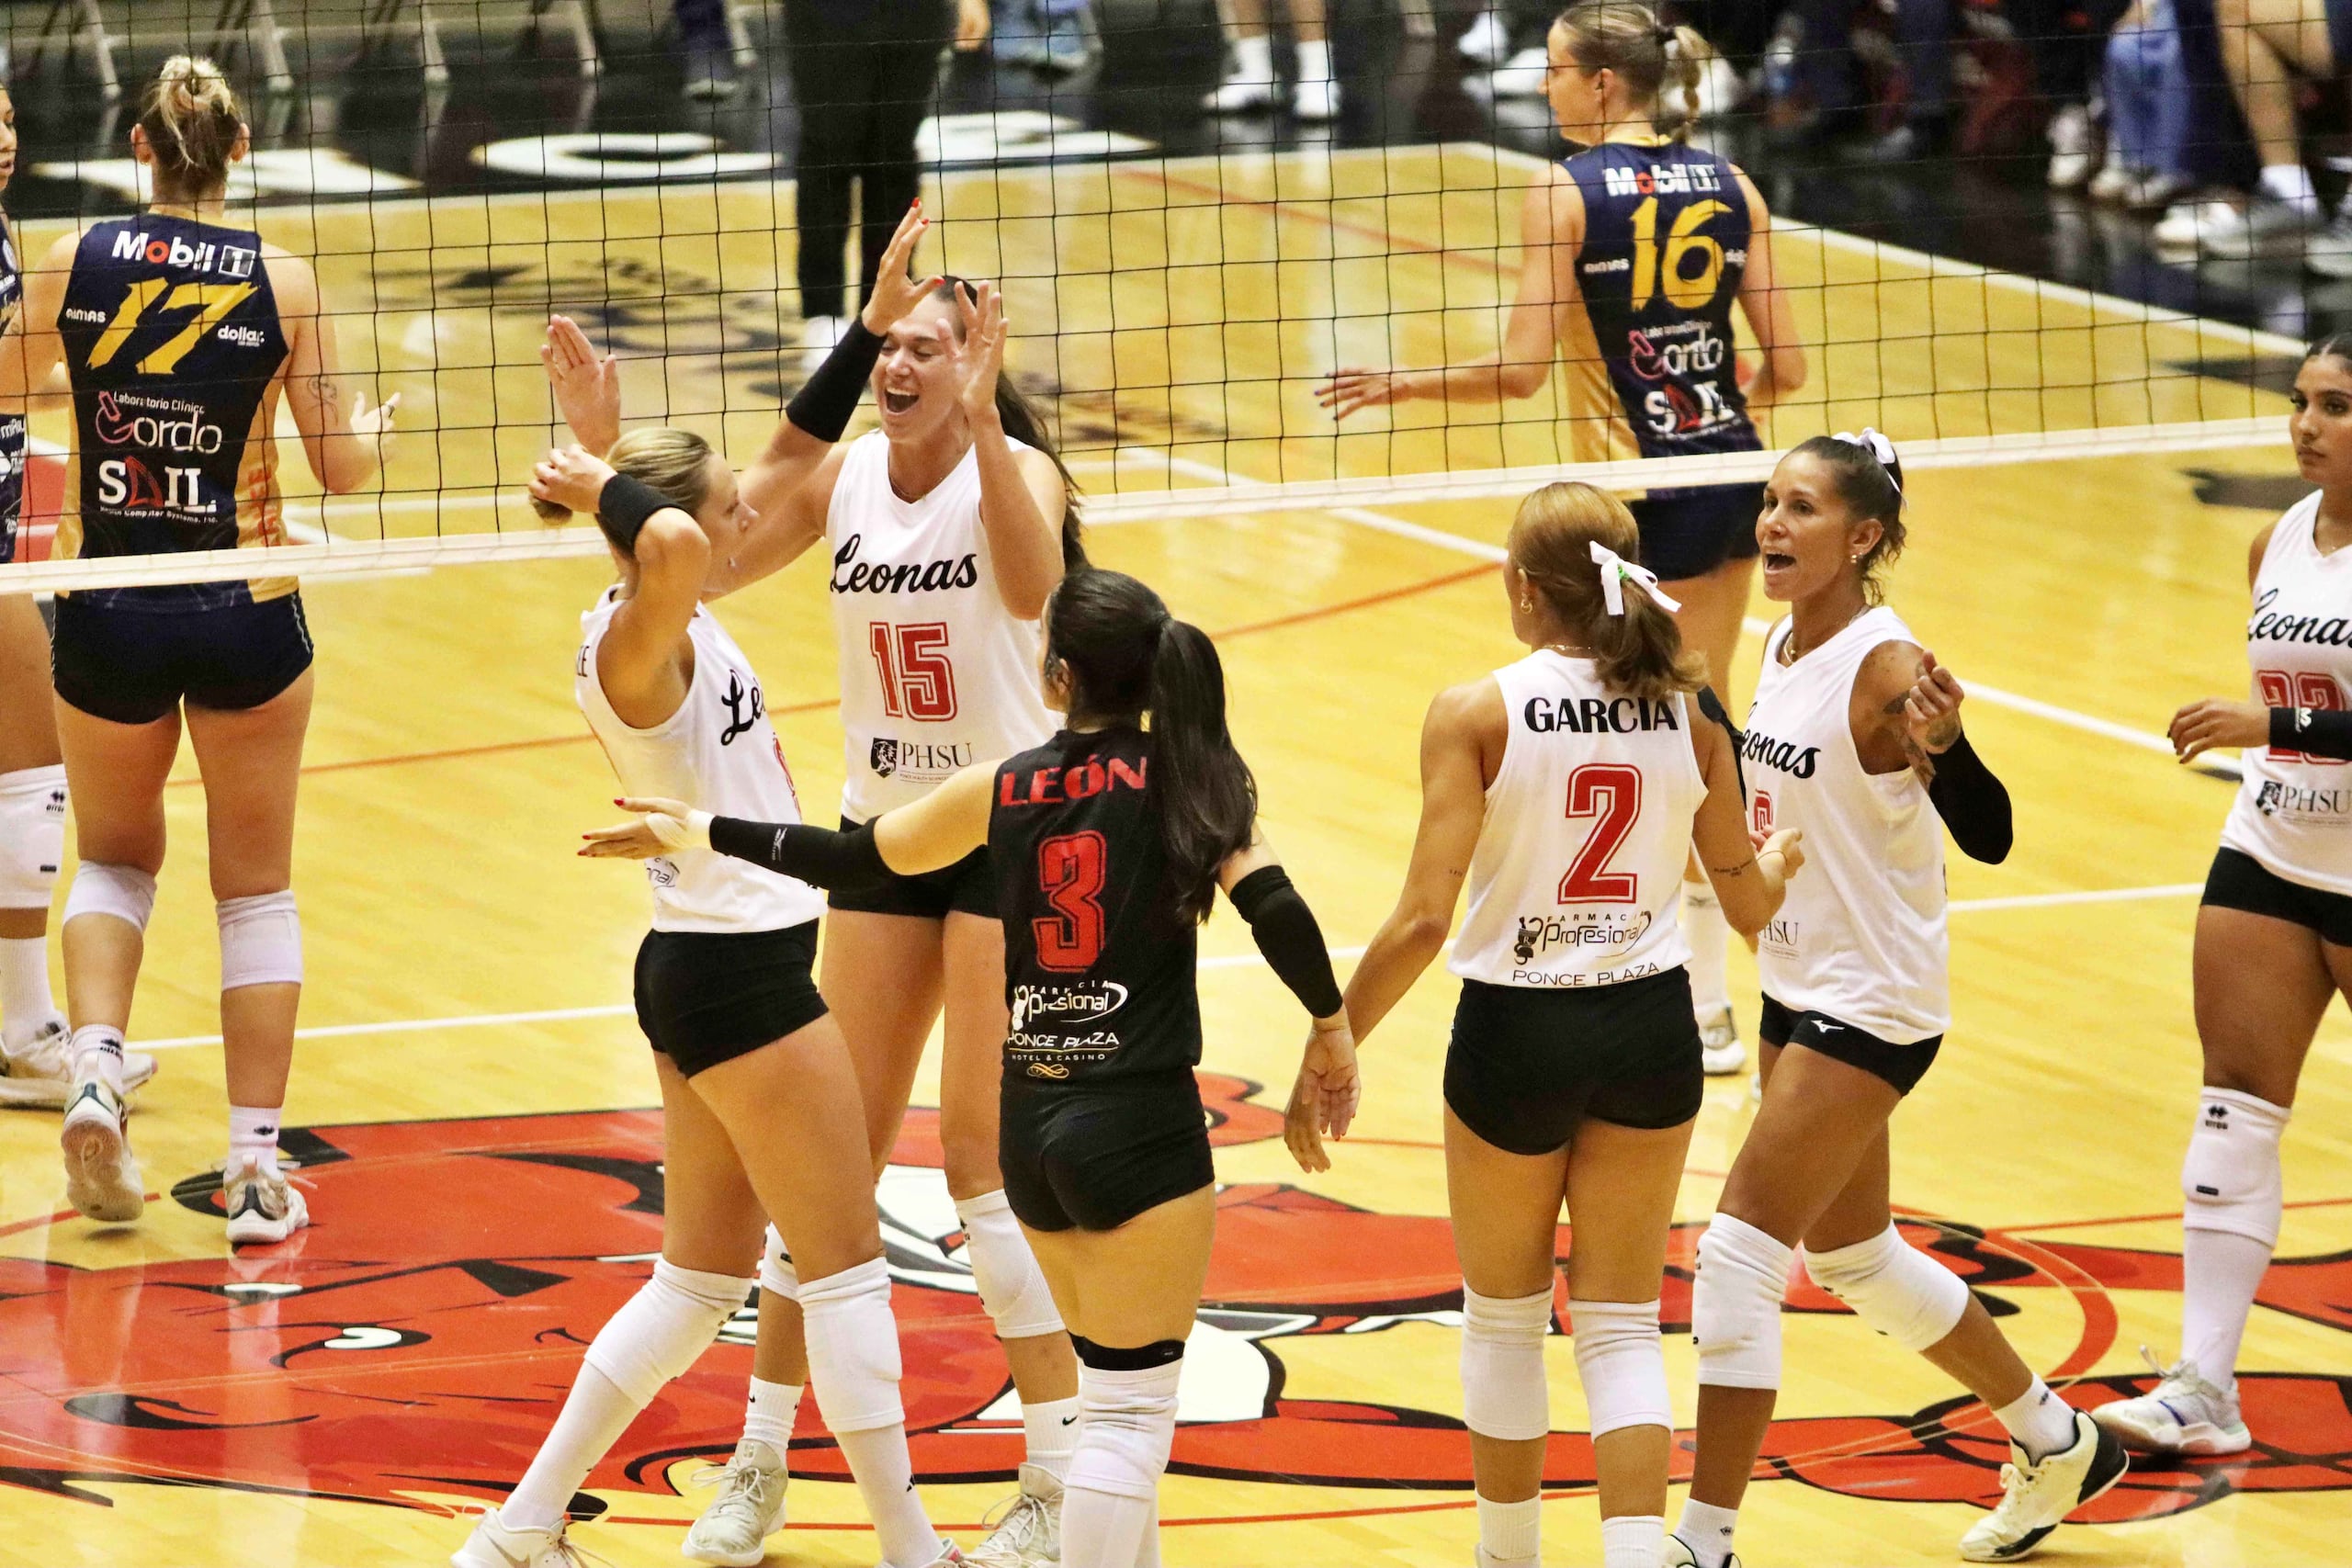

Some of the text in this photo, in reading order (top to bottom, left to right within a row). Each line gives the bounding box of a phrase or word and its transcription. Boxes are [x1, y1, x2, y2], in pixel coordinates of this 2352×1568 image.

[1603, 164, 1691, 196] Mobil
[111, 231, 216, 272] Mobil
[1630, 196, 1733, 312] 16
[85, 277, 260, 374] 17
[96, 390, 222, 454] Gordo
[831, 534, 978, 593] Leonas
[2247, 588, 2352, 649] Leona
[870, 622, 957, 722] 15
[1524, 696, 1679, 734] GARCIA
[1742, 701, 1822, 779] eonas
[900, 741, 972, 770] PHSU
[1000, 753, 1148, 807] LEÓN
[2282, 785, 2352, 814] PHSU
[1557, 762, 1643, 905] 2
[1032, 829, 1107, 974] 3
[1512, 962, 1660, 987] PONCE PLAZA
[1057, 1053, 1105, 1061] CASINO
